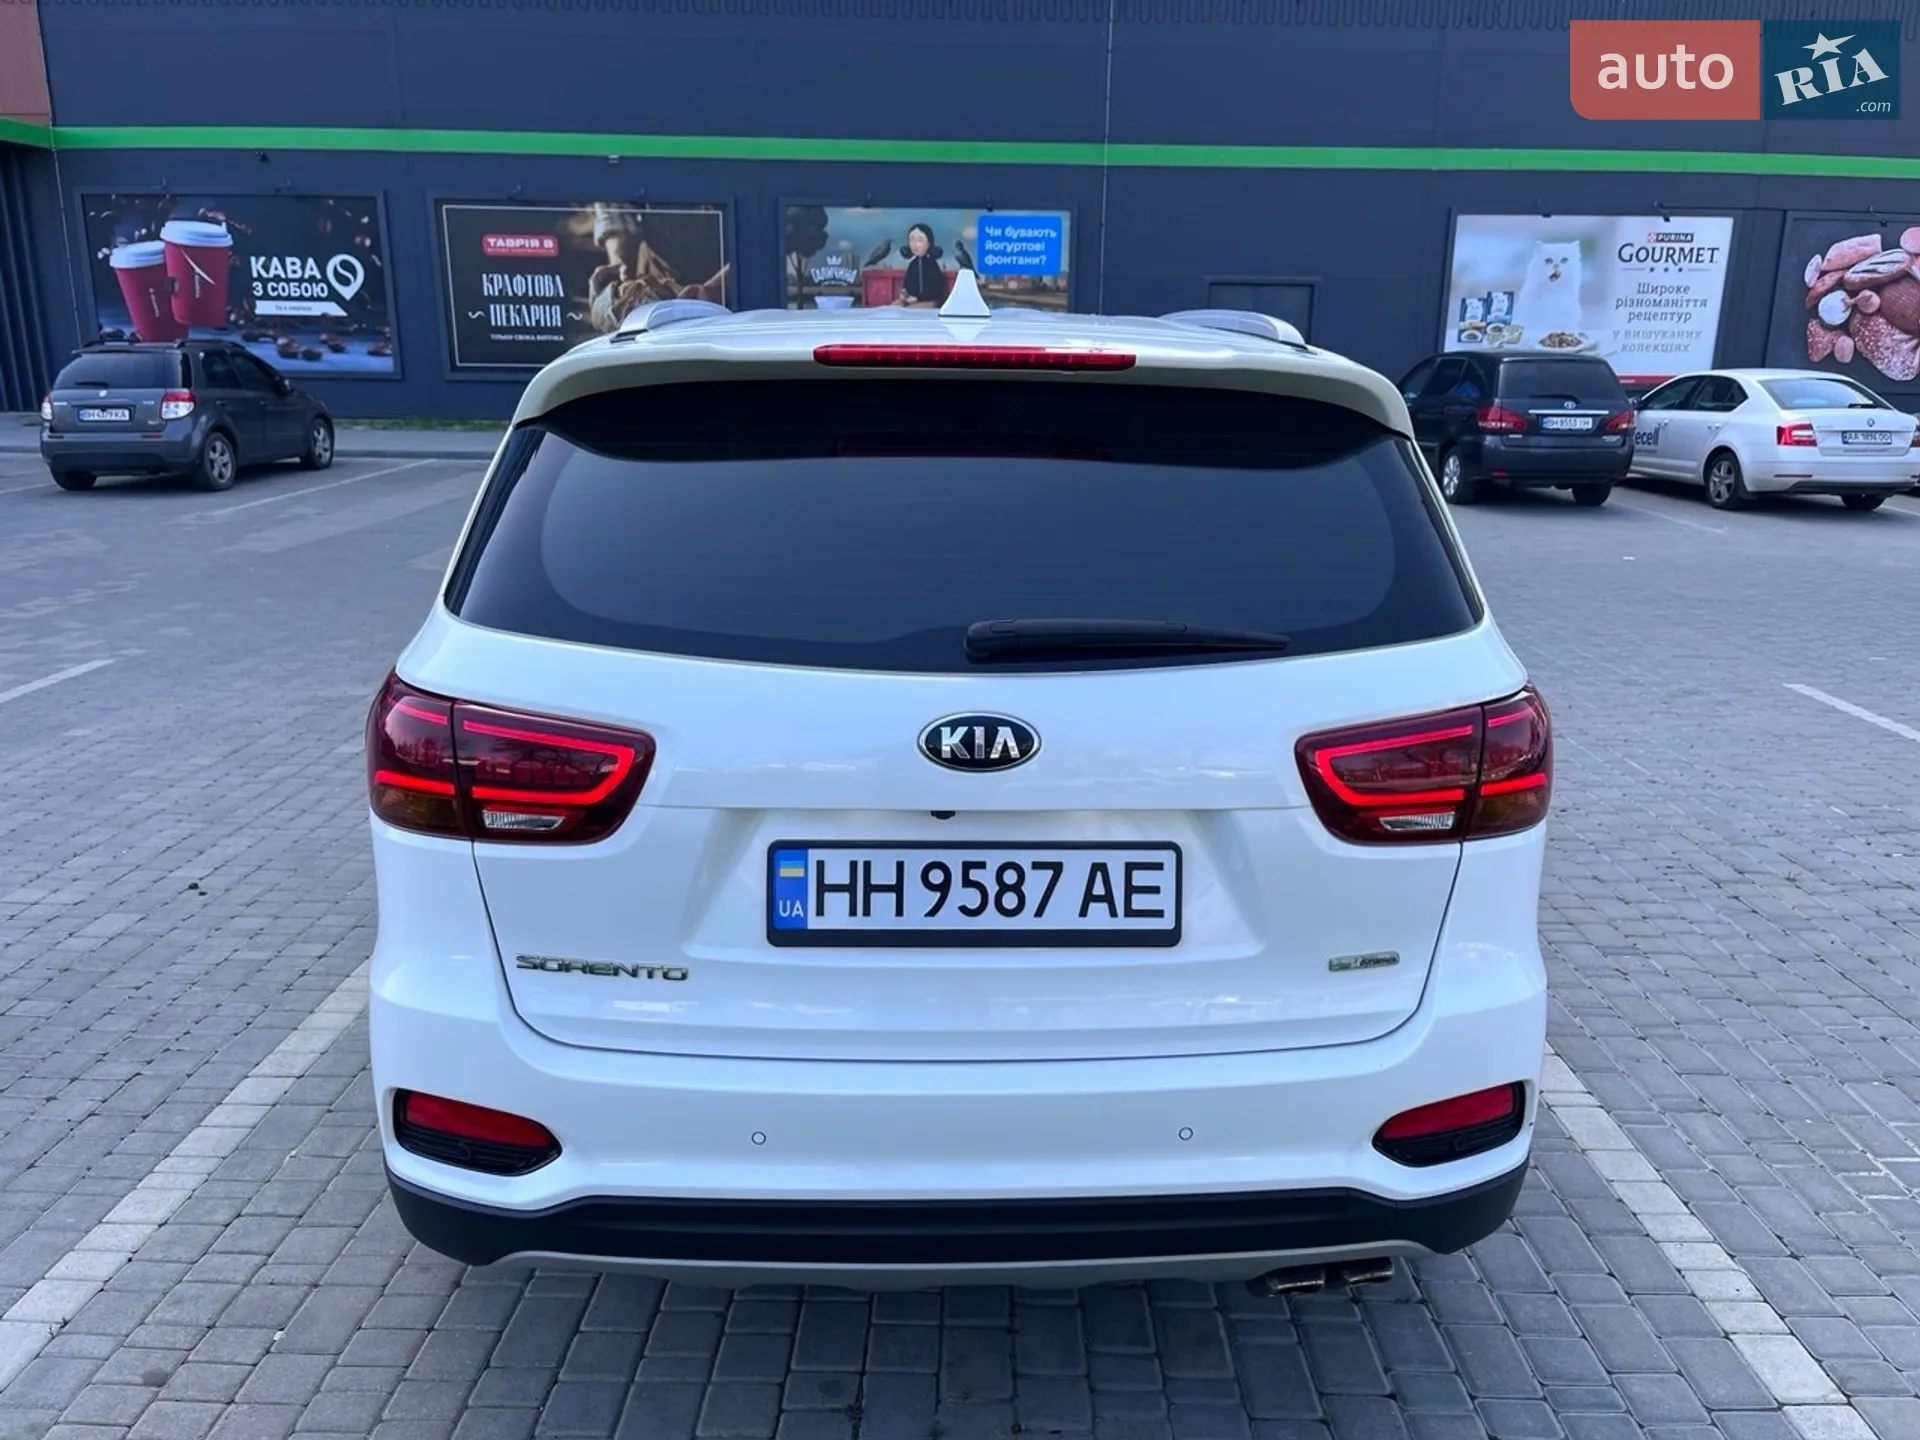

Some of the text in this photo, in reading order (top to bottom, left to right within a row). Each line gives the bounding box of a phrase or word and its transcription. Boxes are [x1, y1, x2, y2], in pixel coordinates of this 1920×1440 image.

[985, 225, 1057, 239] Чи бувають
[1657, 233, 1692, 242] PURINA
[985, 240, 1045, 253] йогуртові
[1617, 242, 1719, 266] GOURMET
[250, 255, 322, 279] КАВА
[984, 254, 1047, 266] фонтани?
[267, 281, 329, 298] СОБОЮ
[482, 273, 565, 297] КРАФТОВА
[1636, 282, 1691, 296] Широке
[1615, 295, 1709, 310] різноманіття
[489, 304, 562, 327] ПЕКАРНЯ
[1627, 311, 1692, 324] рецептур
[1621, 343, 1691, 354] колекціях
[940, 725, 1021, 759] KIA
[815, 860, 1165, 918] HH 9587 AE
[779, 900, 804, 918] UA
[515, 954, 689, 981] SORENTO
